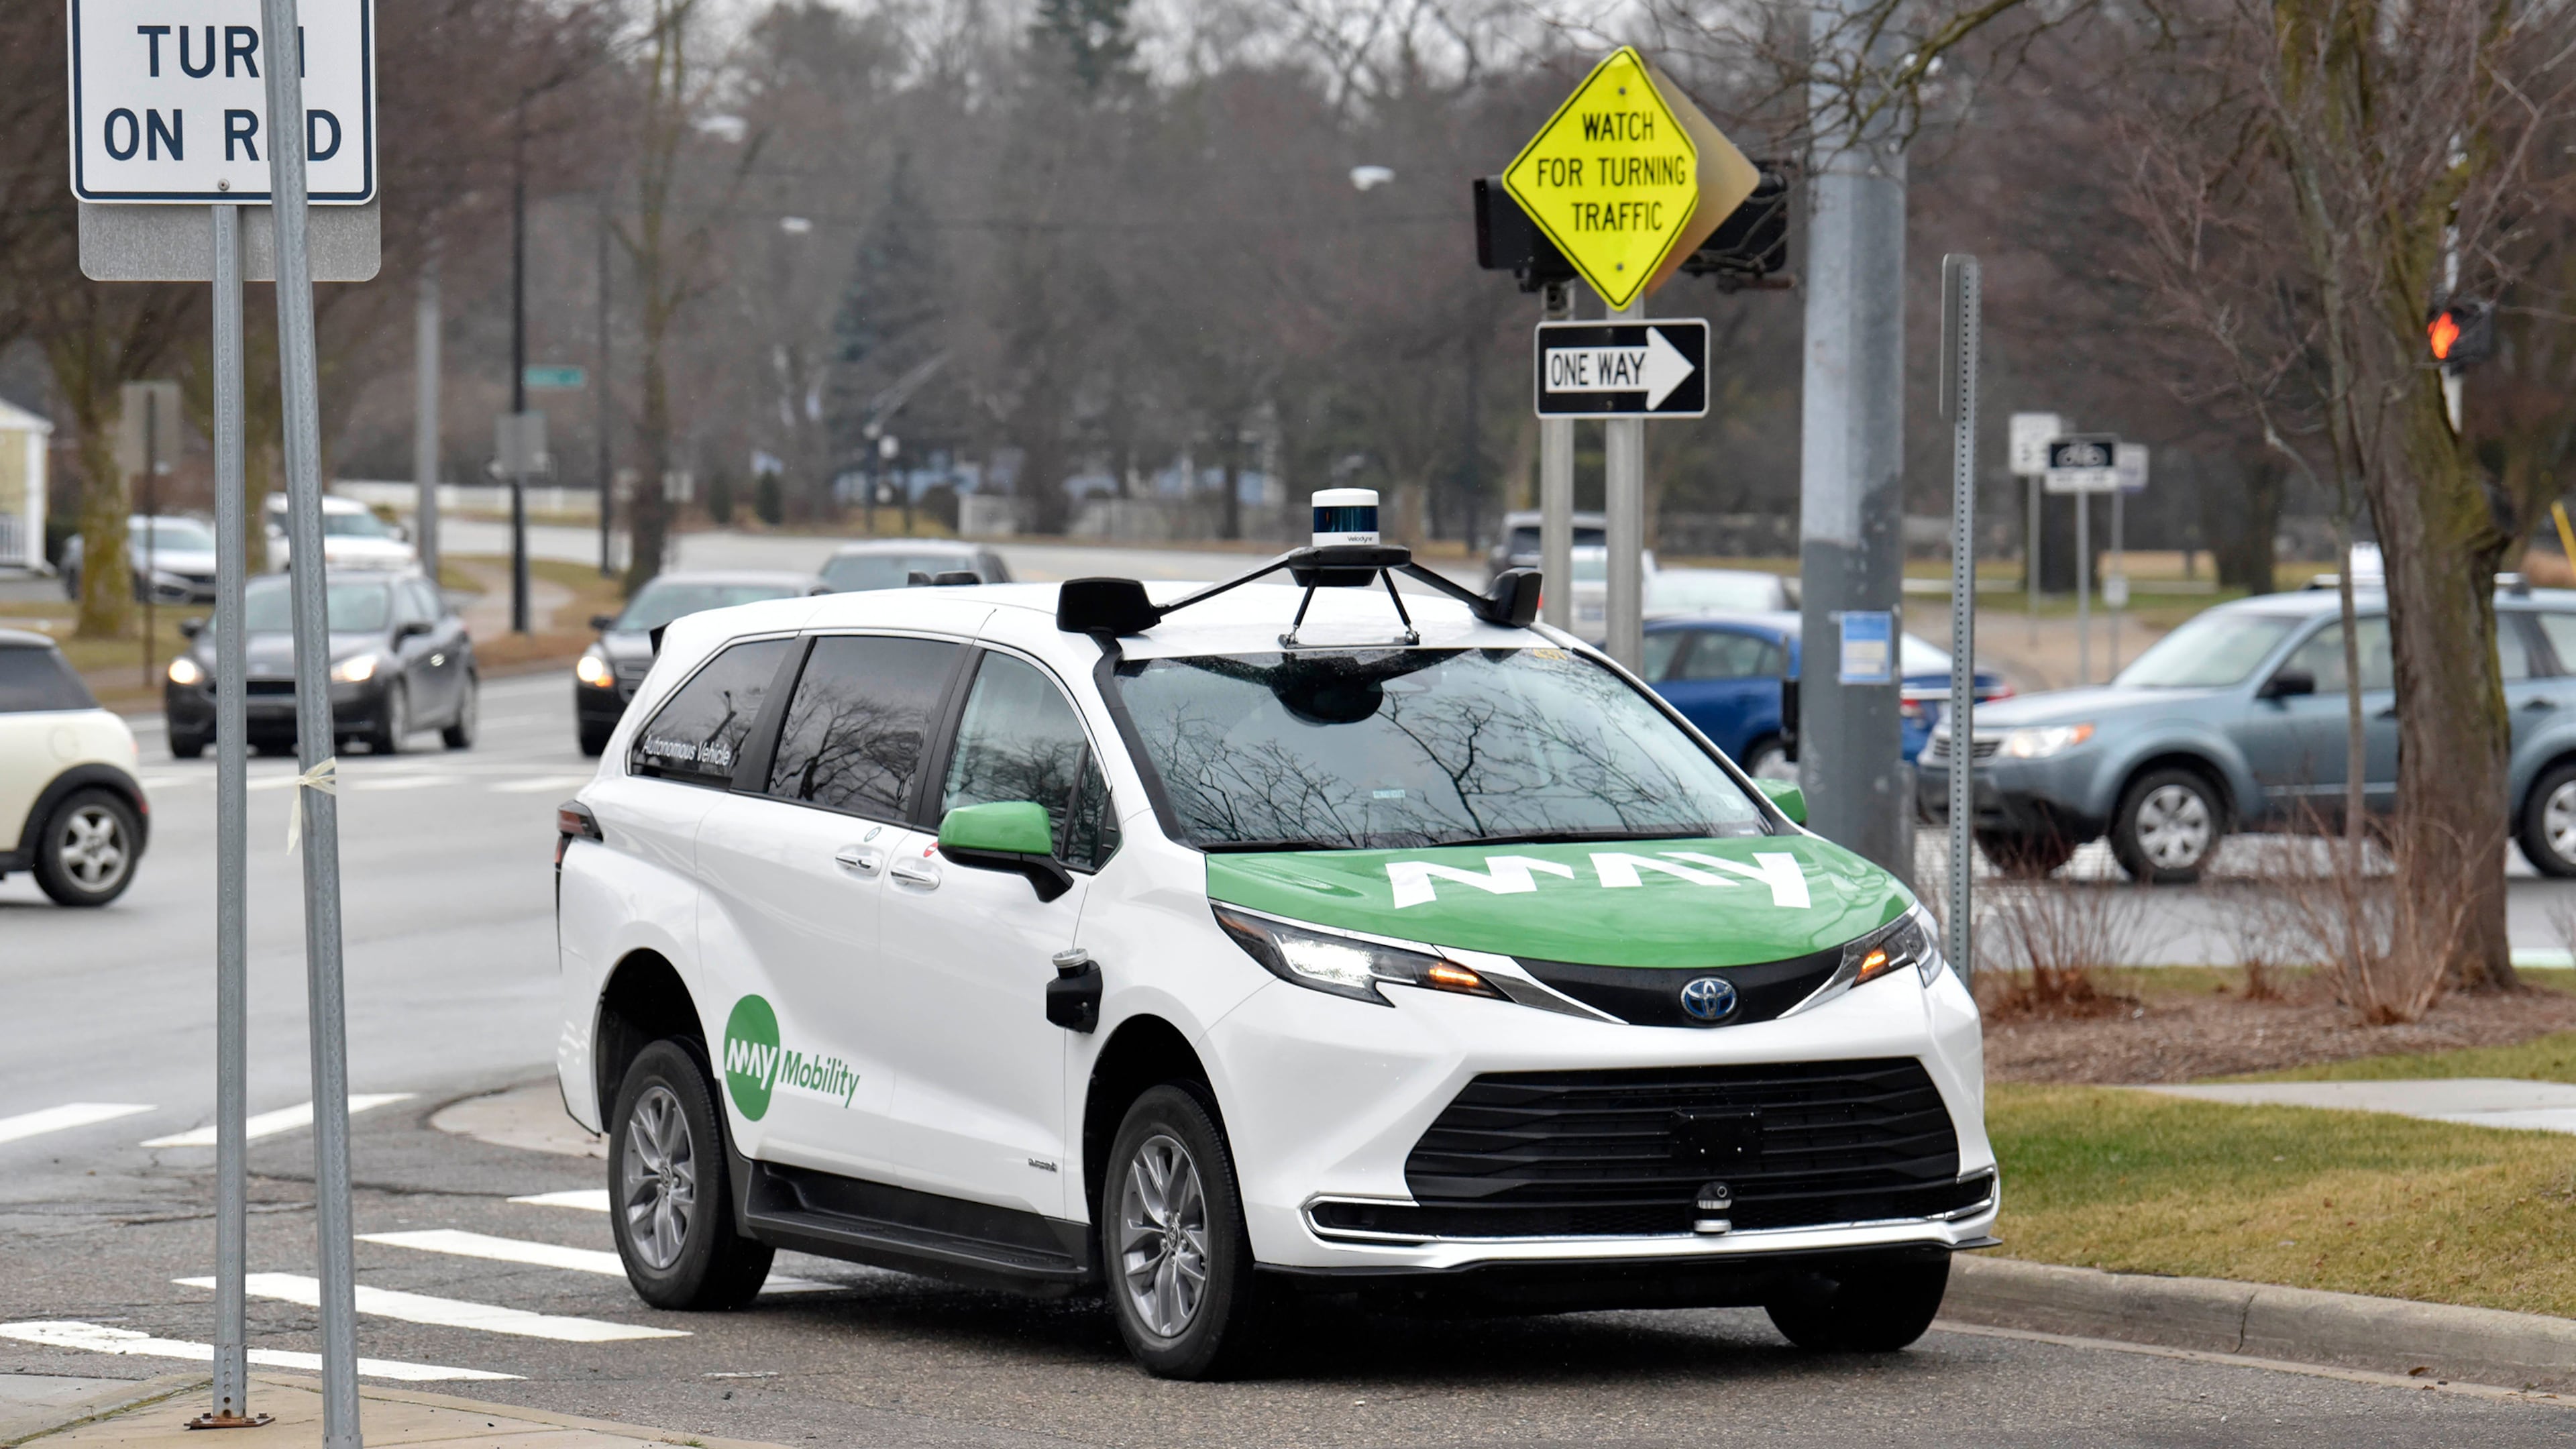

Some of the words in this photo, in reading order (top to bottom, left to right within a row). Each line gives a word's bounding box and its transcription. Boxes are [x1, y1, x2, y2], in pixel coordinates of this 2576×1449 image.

[138, 25, 305, 78] TUR
[104, 107, 183, 161] ON
[225, 109, 341, 161] RD
[1582, 112, 1654, 141] WATCH
[1538, 158, 1583, 187] FOR
[1598, 156, 1686, 186] TURNING
[1571, 202, 1663, 231] TRAFFIC
[1552, 354, 1589, 386] ONE
[1598, 352, 1646, 384] WAY
[641, 735, 696, 761] Autonomous
[696, 741, 731, 766] Vehicle
[1385, 852, 1811, 909] MAY
[726, 1038, 778, 1091] MAY
[780, 1050, 860, 1109] Mobility
